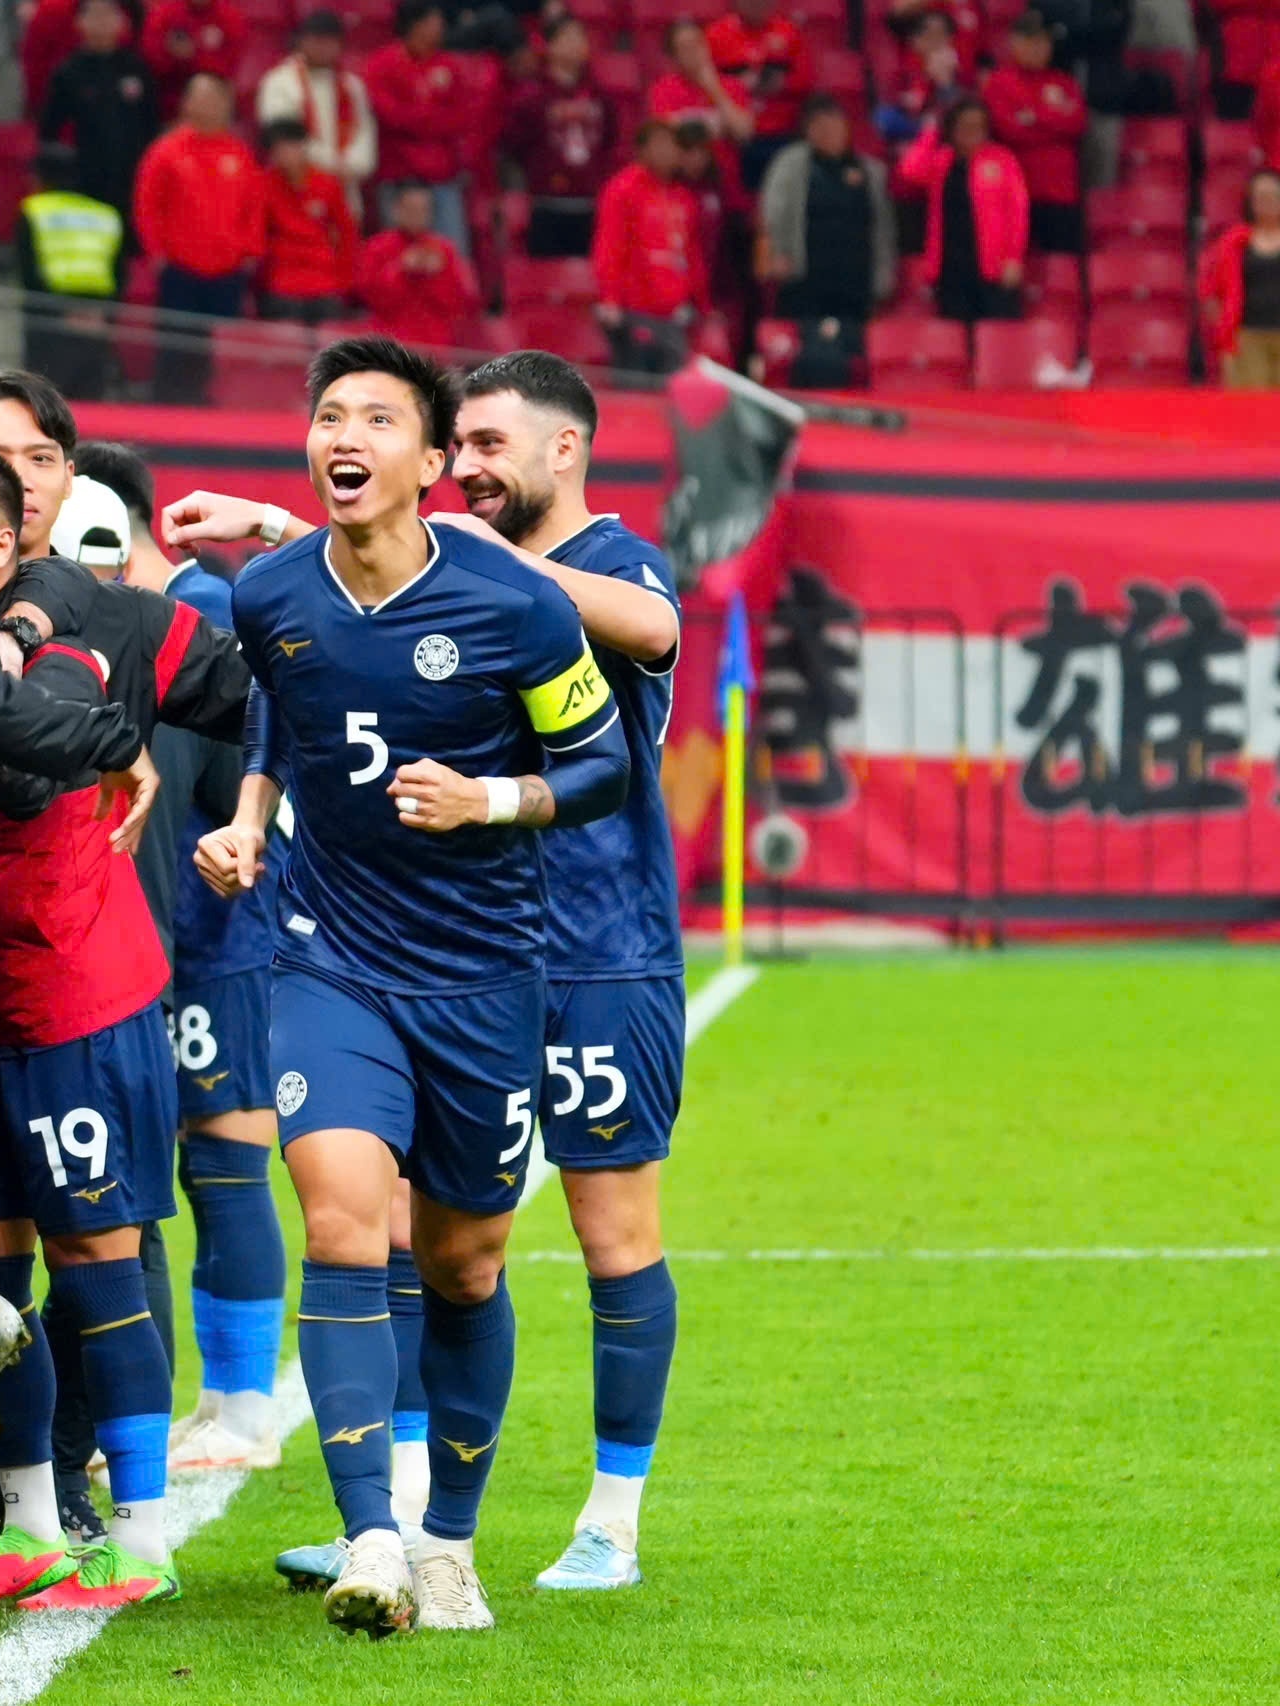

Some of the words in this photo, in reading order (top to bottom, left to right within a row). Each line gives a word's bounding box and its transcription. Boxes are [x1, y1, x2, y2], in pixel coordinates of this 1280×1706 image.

[557, 664, 602, 718] AF
[346, 711, 389, 786] 5
[545, 1045, 627, 1119] 55
[28, 1107, 108, 1188] 19
[499, 1088, 532, 1164] 5
